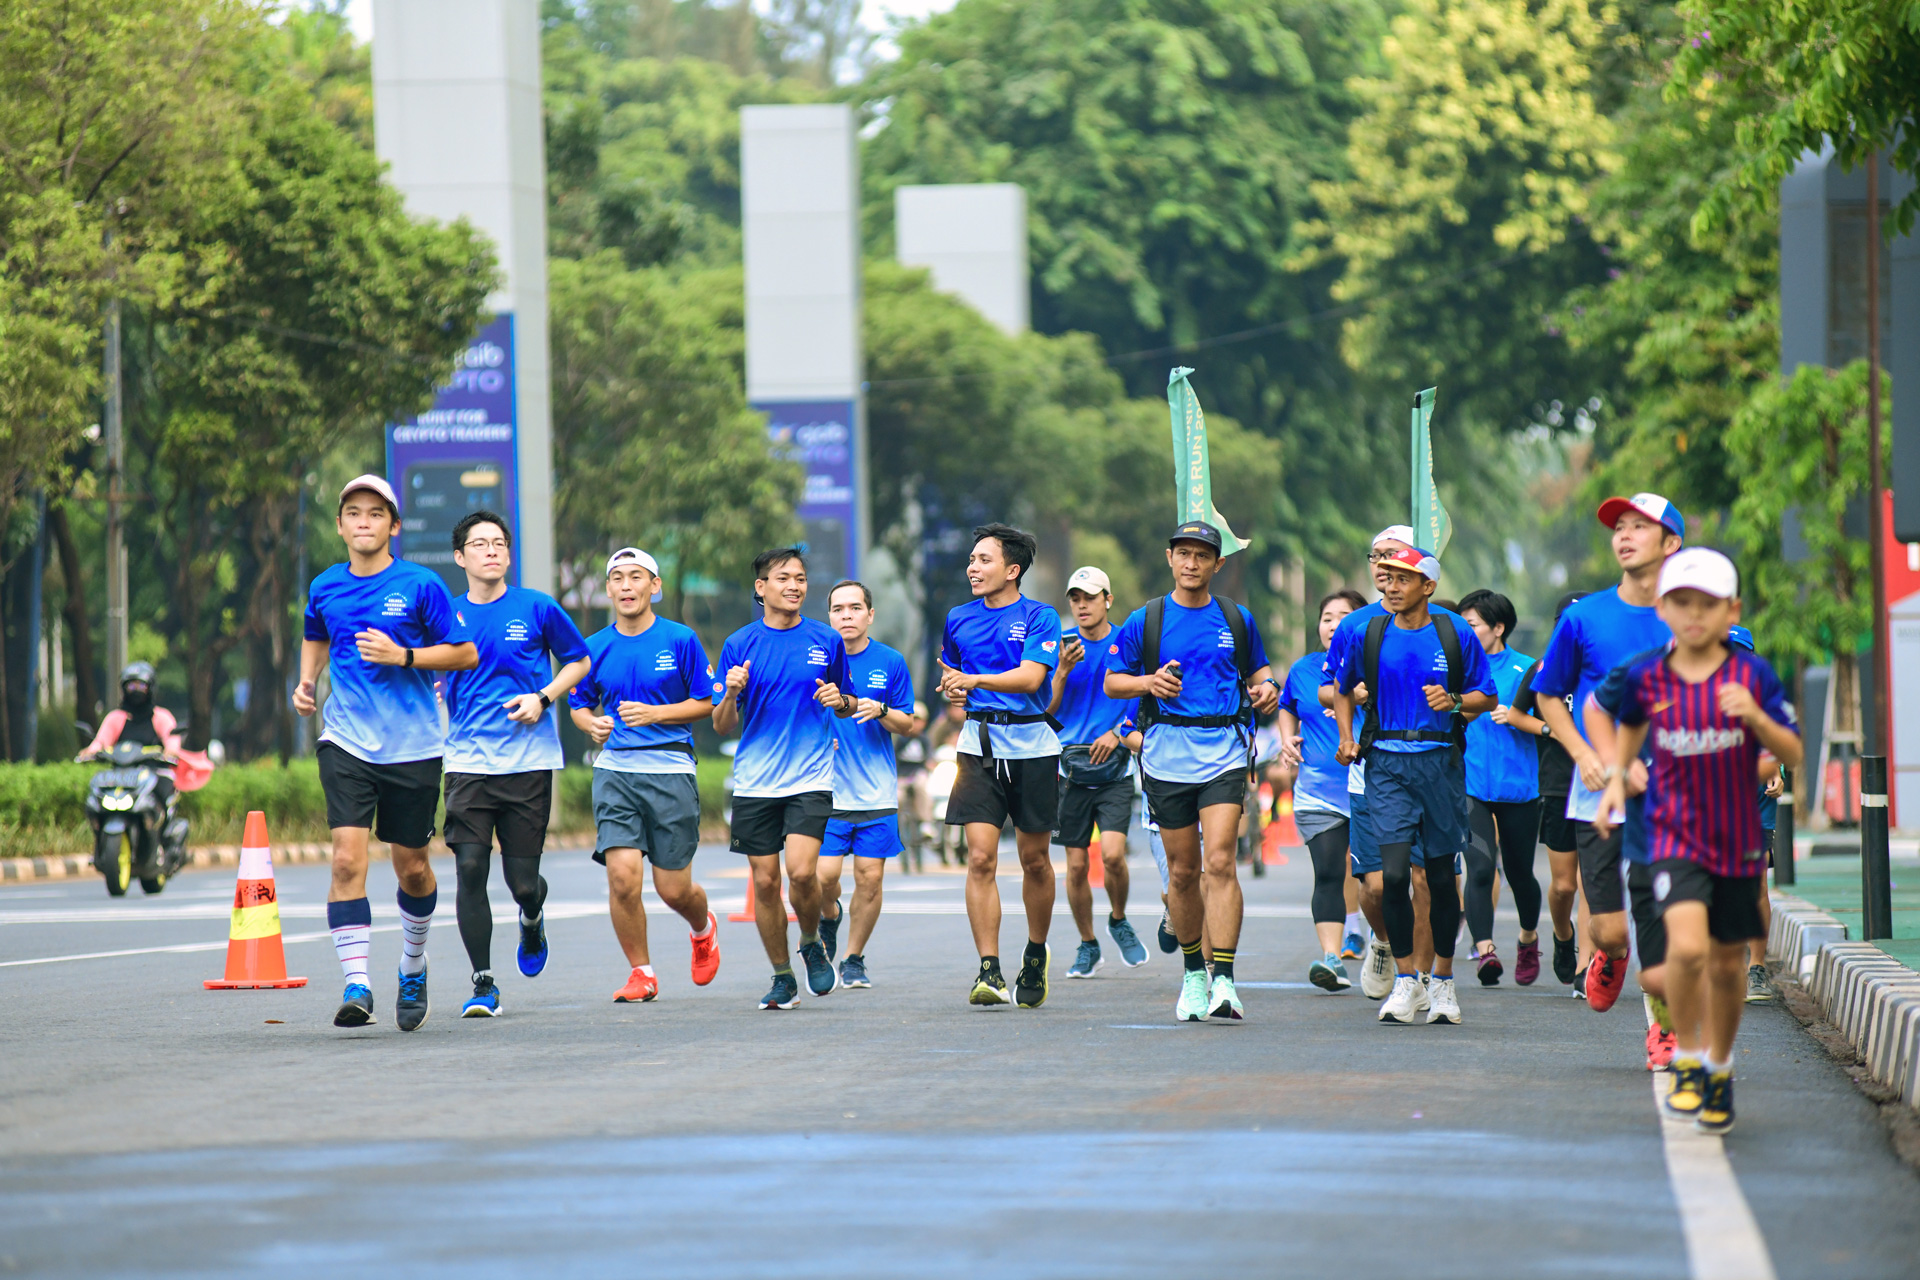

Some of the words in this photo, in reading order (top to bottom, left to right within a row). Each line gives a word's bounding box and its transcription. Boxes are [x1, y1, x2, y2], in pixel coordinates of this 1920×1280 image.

[393, 425, 450, 443] CRYPTO
[450, 423, 512, 442] TRADERS
[1191, 435, 1204, 479] RUN
[1192, 483, 1204, 497] &
[1657, 725, 1745, 753] Rakuten
